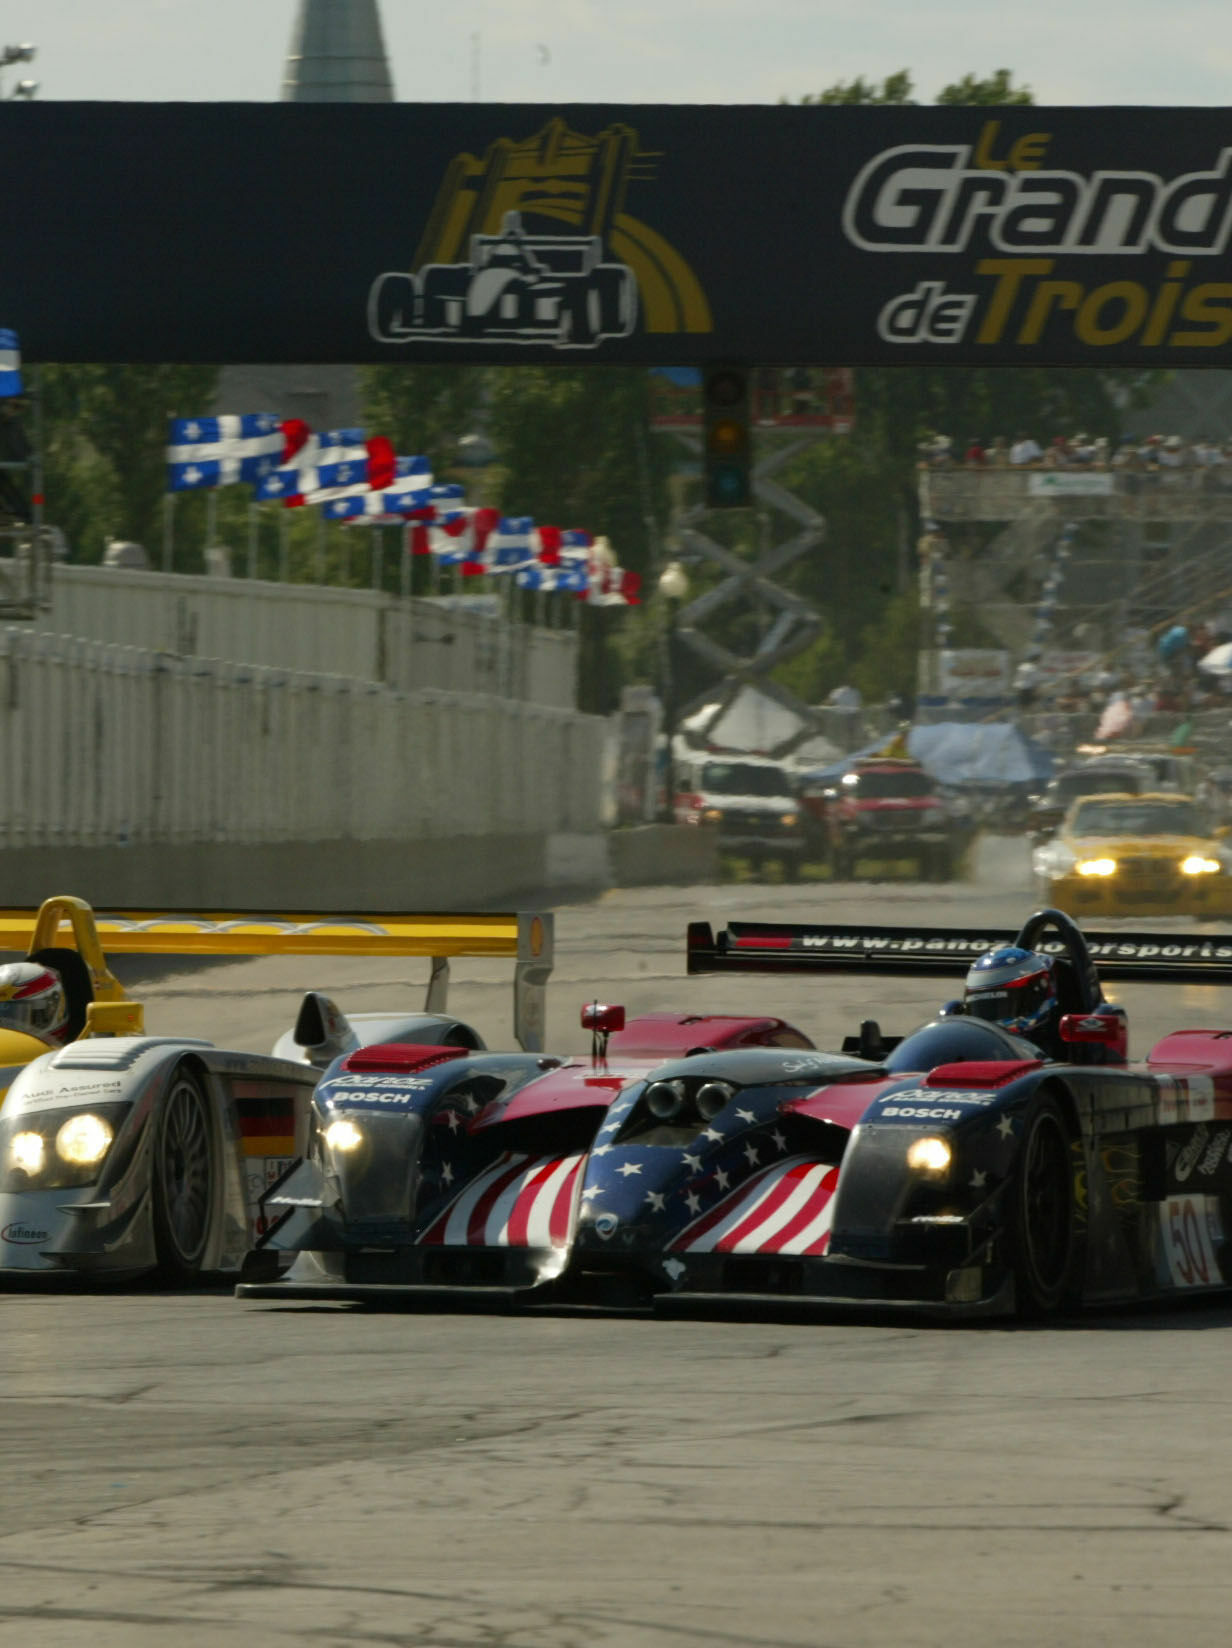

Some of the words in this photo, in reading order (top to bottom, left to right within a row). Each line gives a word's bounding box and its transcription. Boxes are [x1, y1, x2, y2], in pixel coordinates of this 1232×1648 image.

[841, 144, 1232, 255] Grand
[975, 259, 1232, 347] Trois
[332, 1092, 411, 1103] BOSCH
[881, 1106, 962, 1120] BOSCH
[1168, 1198, 1210, 1285] 50
